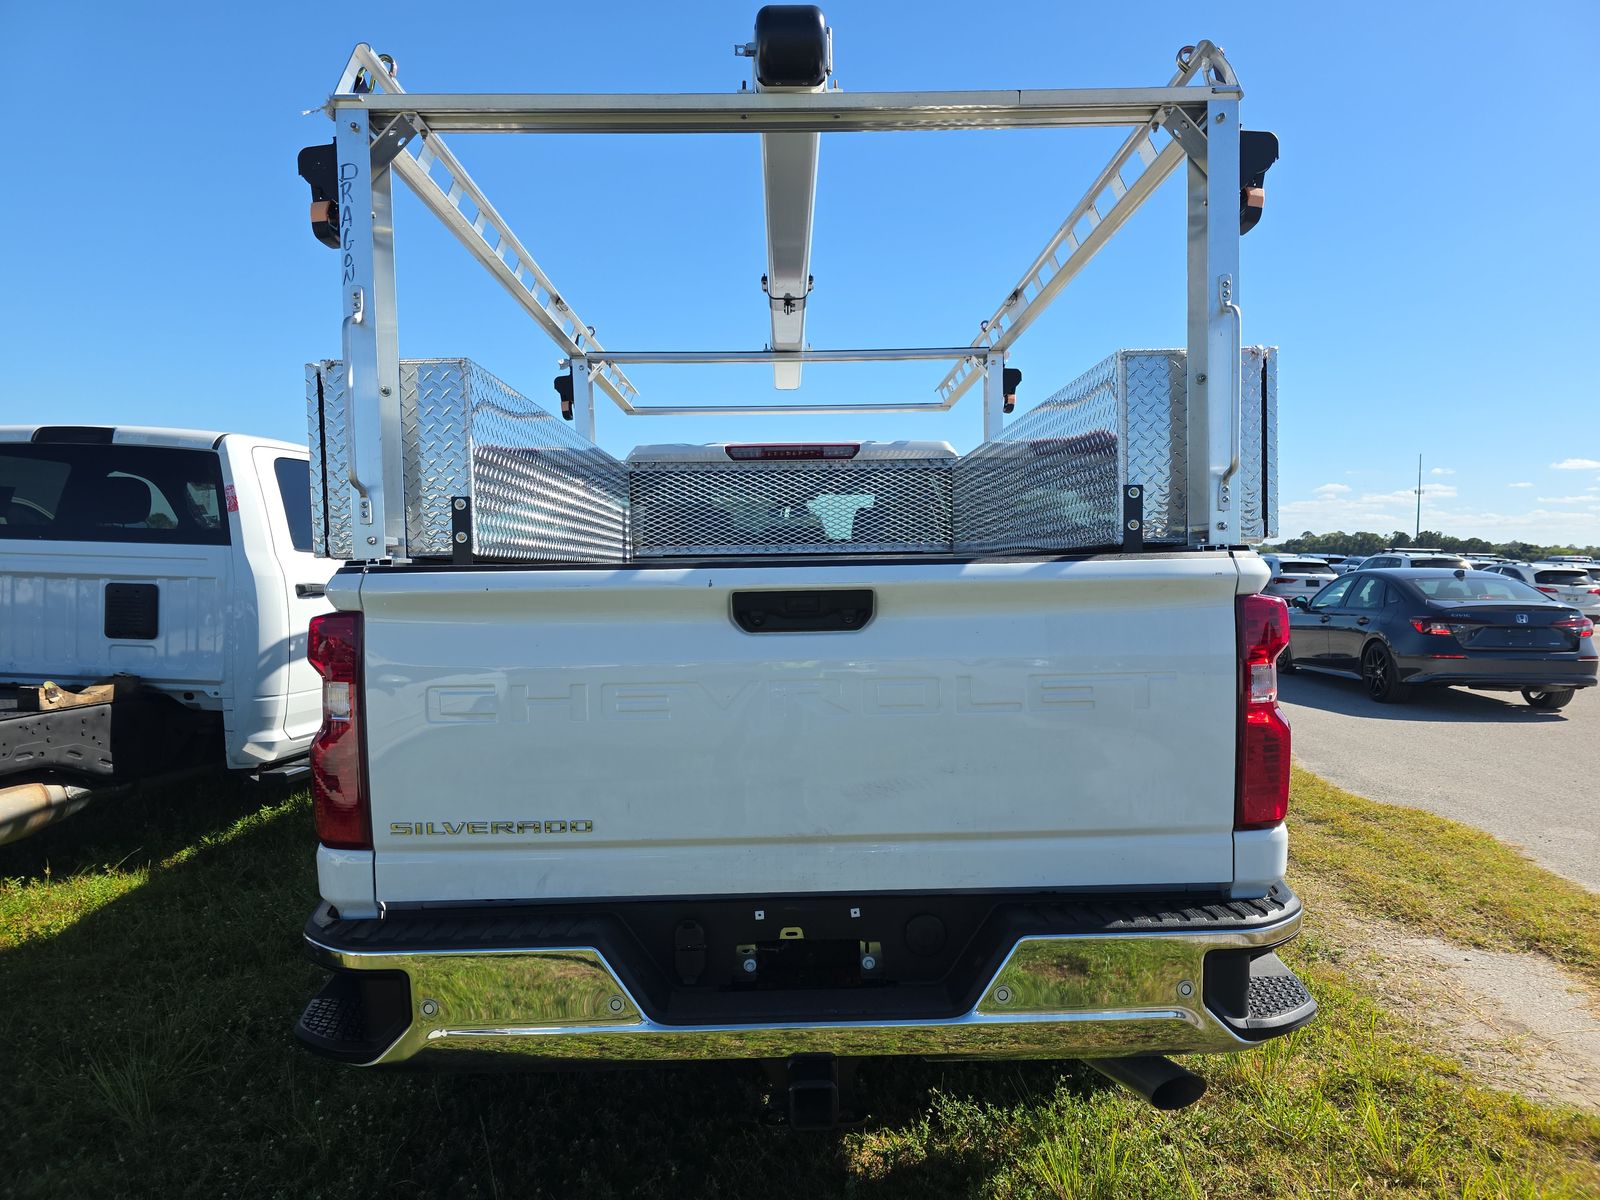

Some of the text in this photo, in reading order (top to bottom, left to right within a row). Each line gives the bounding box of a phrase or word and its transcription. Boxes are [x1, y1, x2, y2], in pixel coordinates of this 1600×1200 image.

[339, 163, 358, 286] DRAGON
[425, 671, 1177, 724] CHEVROLET
[389, 819, 594, 836] SILVERADO
